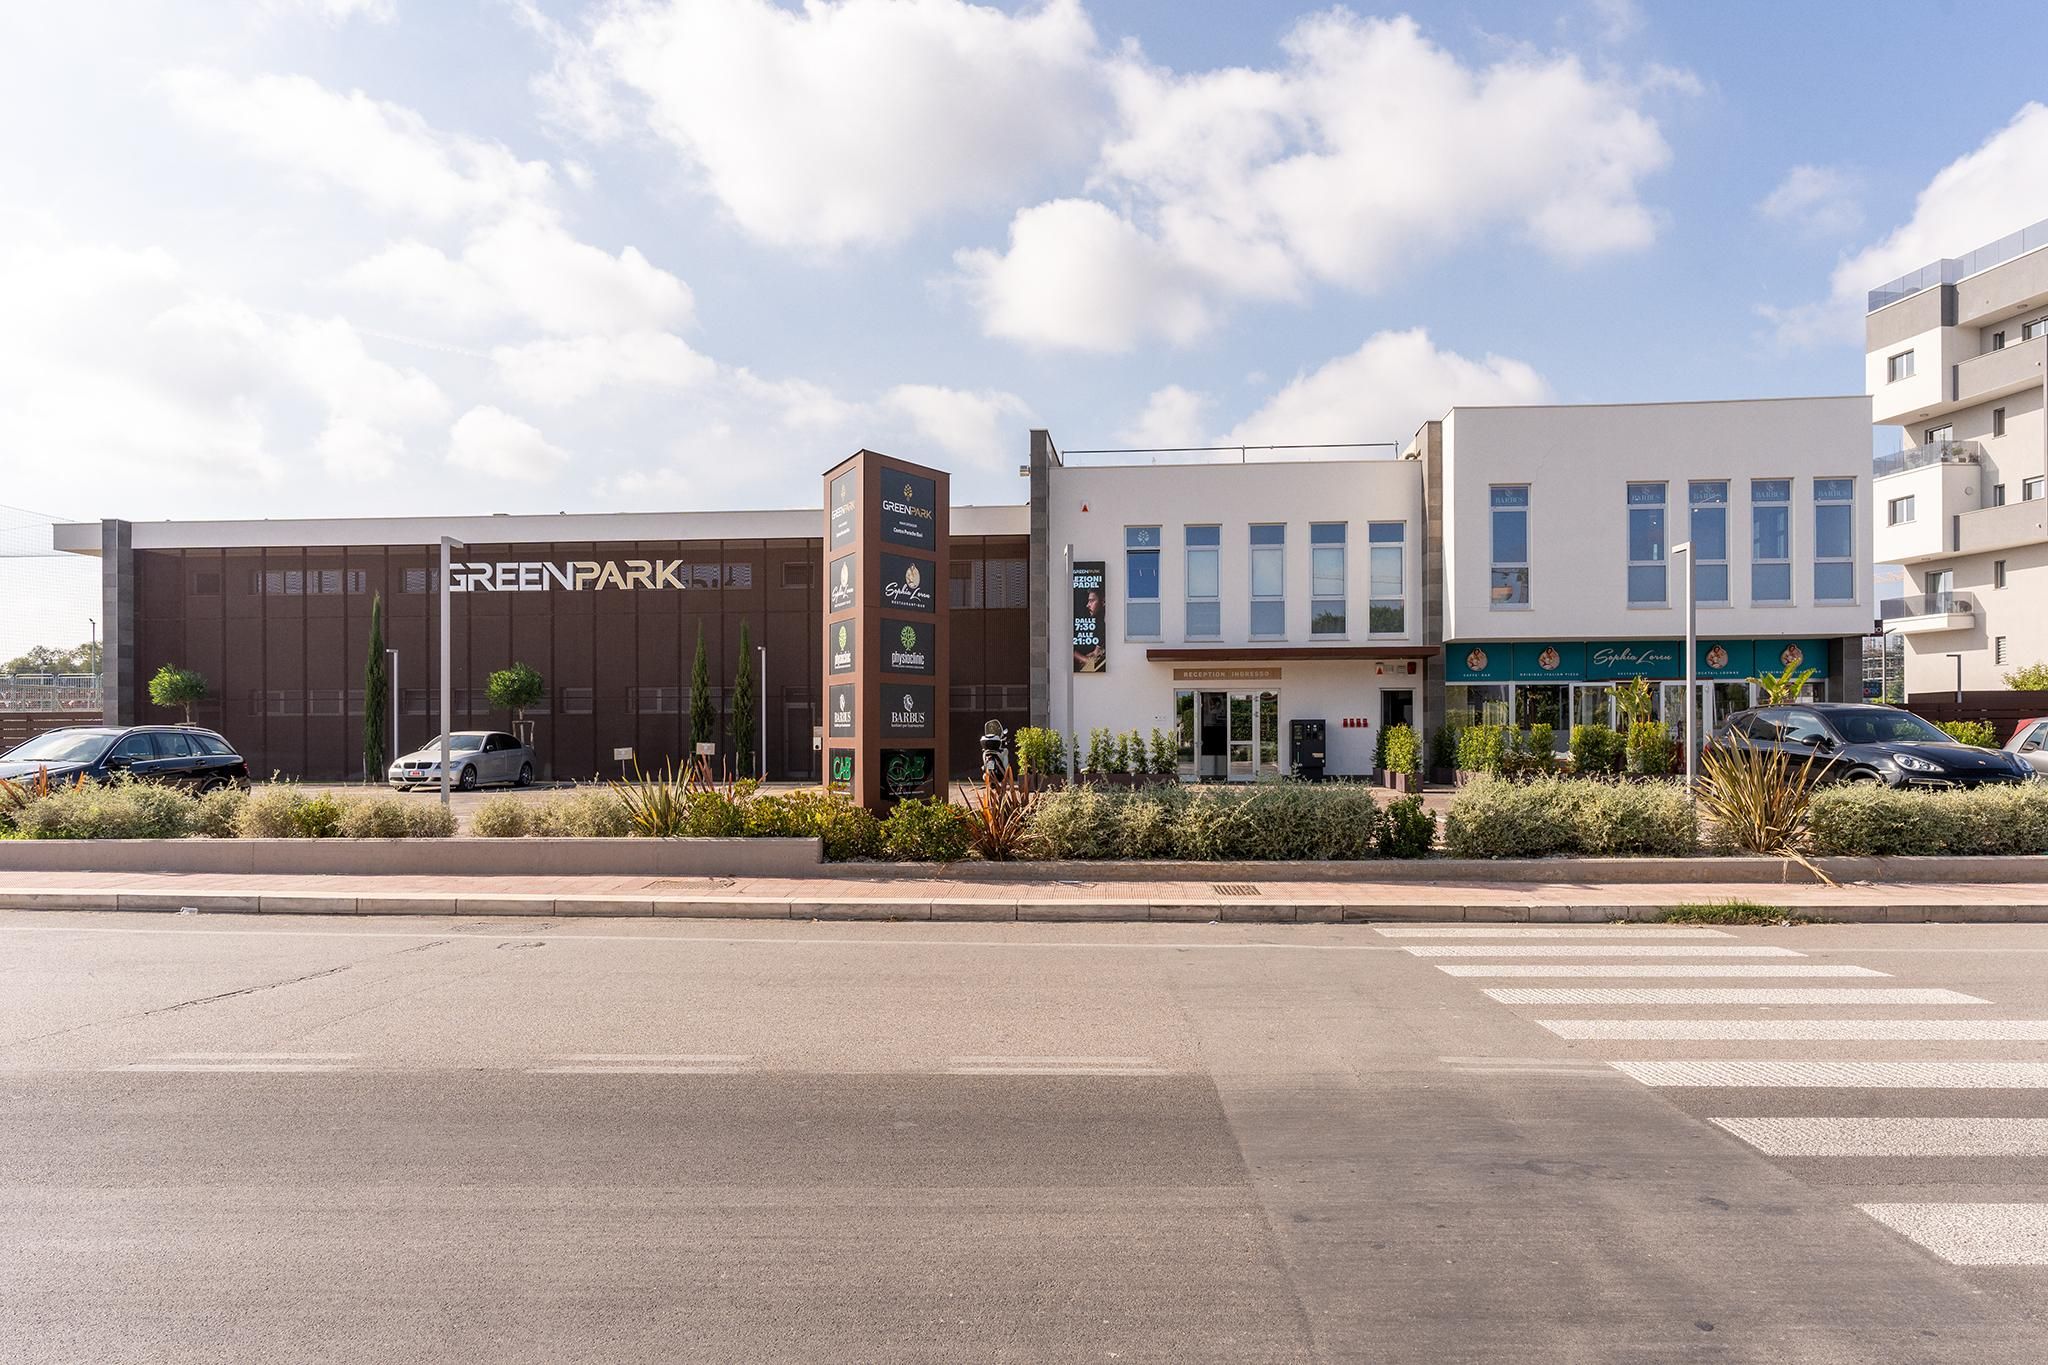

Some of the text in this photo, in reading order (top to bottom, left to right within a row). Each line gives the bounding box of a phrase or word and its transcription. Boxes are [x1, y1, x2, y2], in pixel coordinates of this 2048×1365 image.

[882, 500, 932, 520] GREENPARK
[449, 560, 686, 591] GREENPARK
[1075, 623, 1096, 631] 7:30
[1073, 637, 1100, 645] 21:00
[892, 650, 925, 665] physioclinic
[1593, 648, 1672, 668] Sophia Loren
[891, 711, 925, 723] BARBUS
